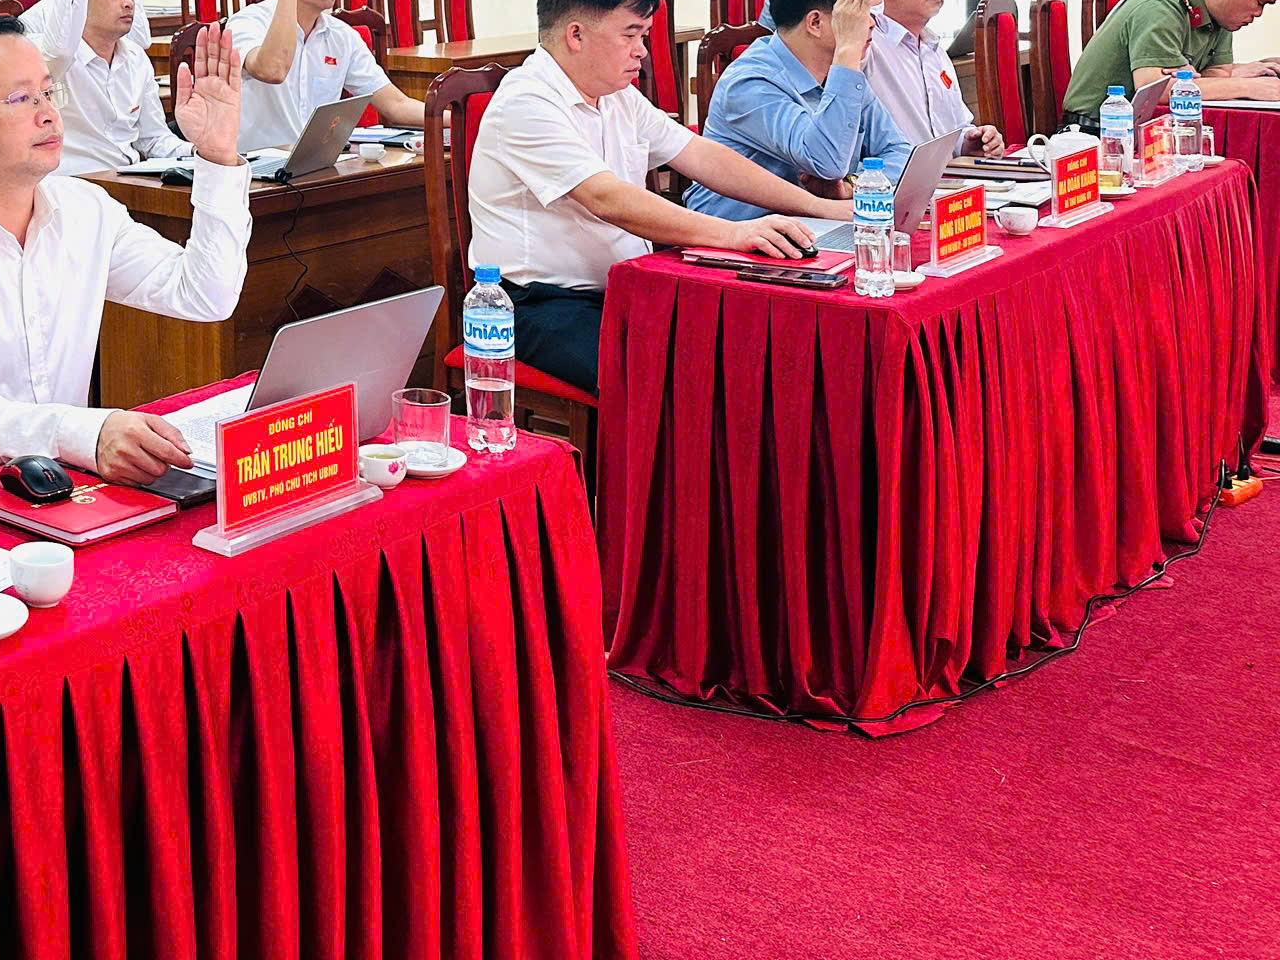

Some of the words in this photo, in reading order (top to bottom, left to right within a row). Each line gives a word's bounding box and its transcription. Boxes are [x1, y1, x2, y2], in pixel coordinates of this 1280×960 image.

[273, 435, 313, 471] TRUNG
[316, 418, 344, 457] HIẾU
[319, 464, 339, 481] UBND
